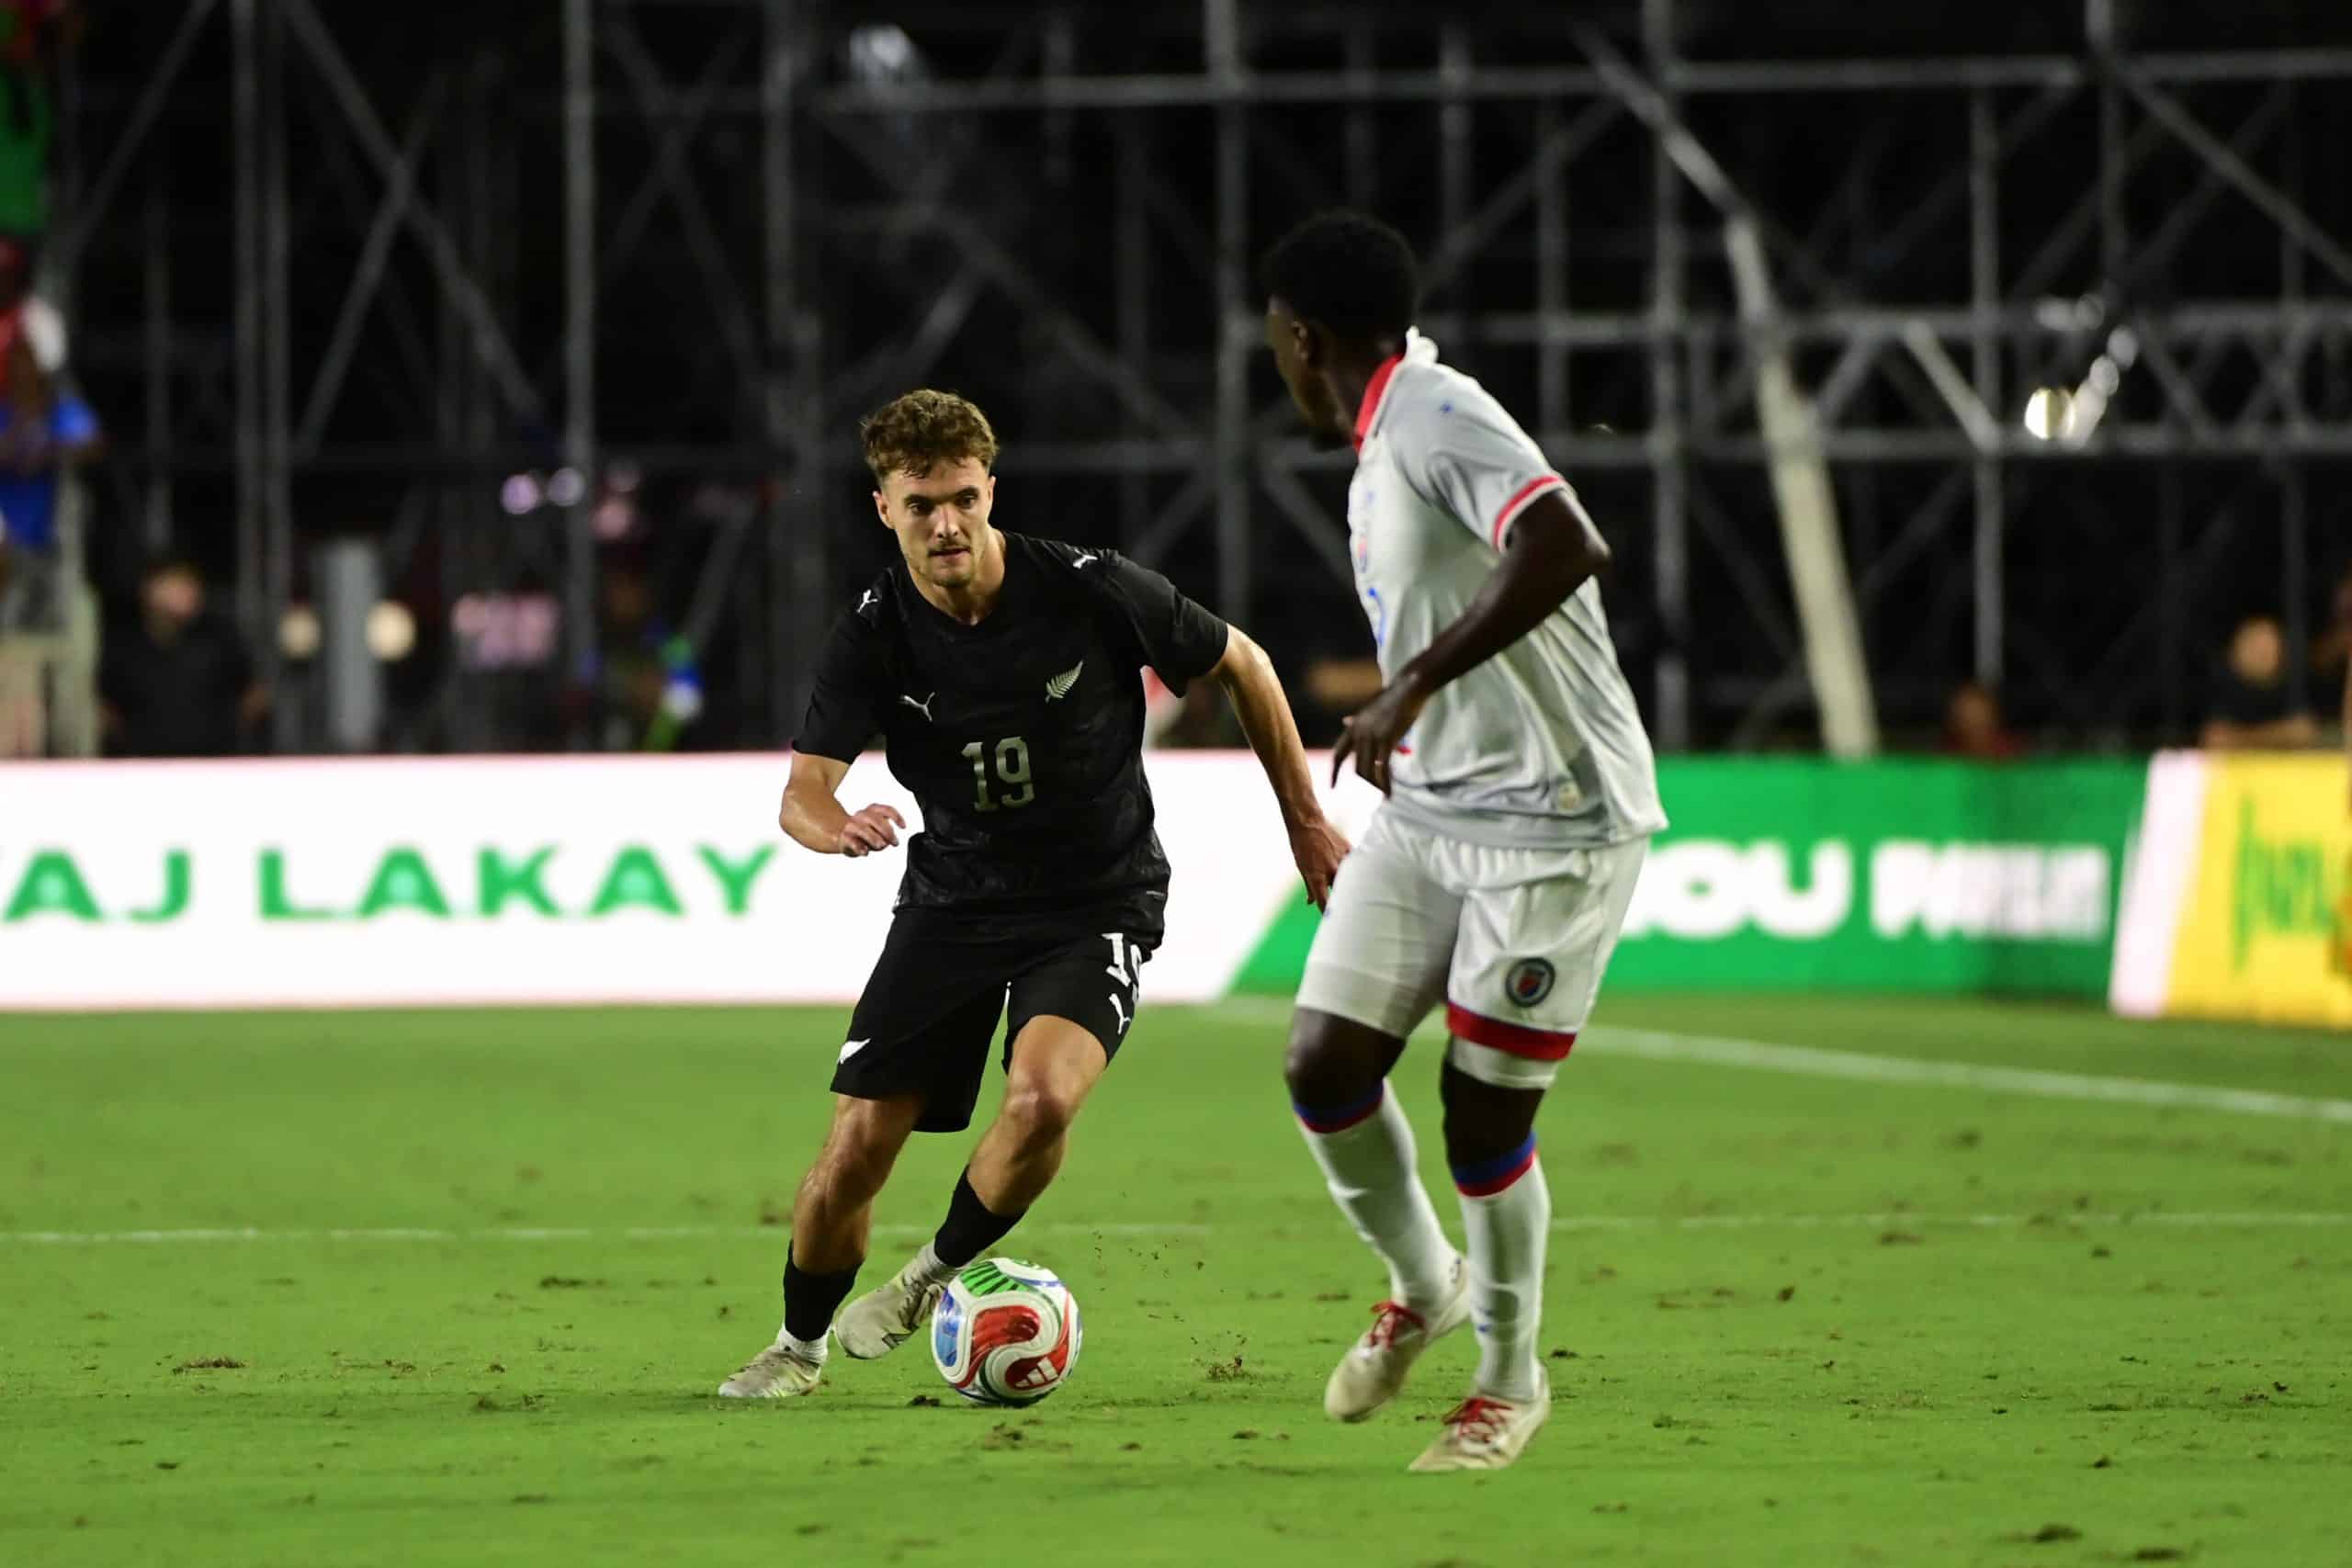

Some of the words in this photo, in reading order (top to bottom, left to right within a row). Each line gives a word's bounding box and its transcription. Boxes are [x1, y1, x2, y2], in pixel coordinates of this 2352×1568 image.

[961, 736, 1035, 812] 19
[0, 849, 192, 921] AJ
[258, 845, 777, 920] LAKAY
